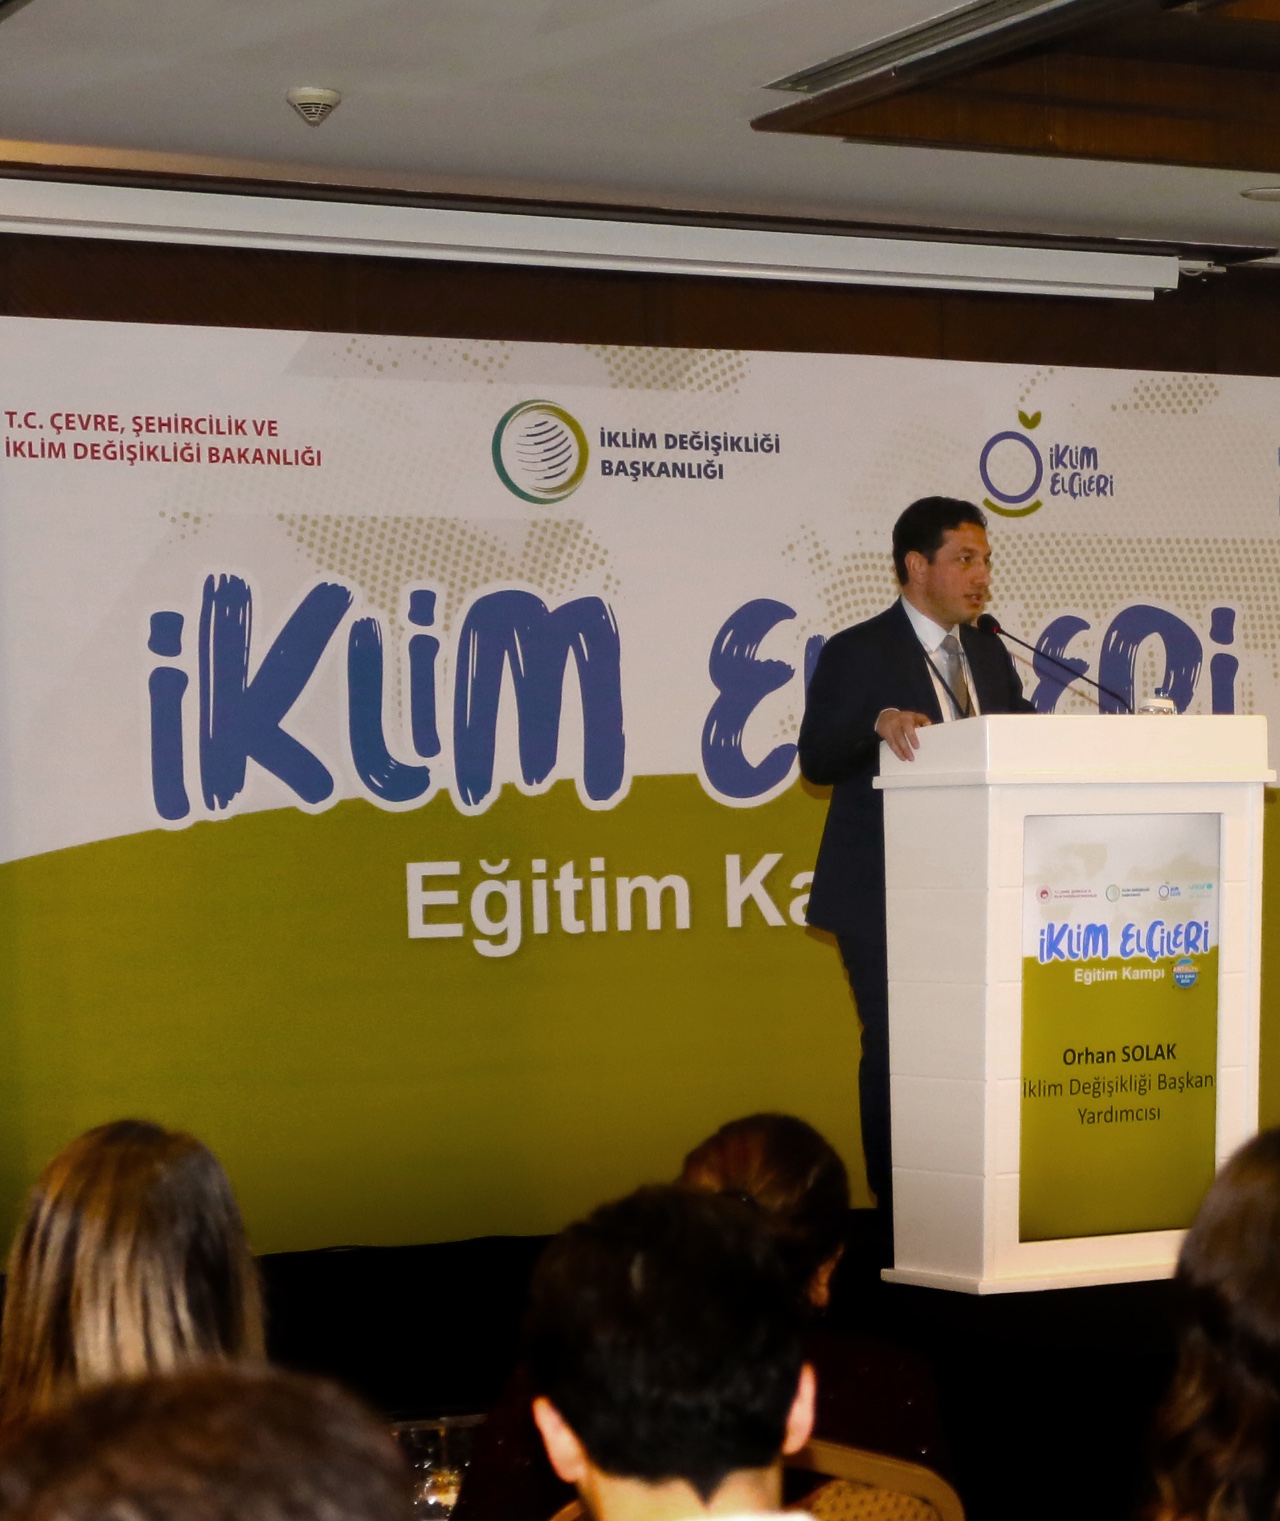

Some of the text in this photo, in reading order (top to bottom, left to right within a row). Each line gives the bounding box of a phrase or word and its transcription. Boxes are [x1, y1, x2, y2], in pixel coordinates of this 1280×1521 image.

[4, 411, 278, 437] T.C. ÇEVRE, ŞEHİRCİLİK VE
[4, 436, 322, 467] İKLİM DEĞİŞİKLİĞİ BAKANLIĞI
[599, 426, 780, 456] İKLİM DEĞİŞİKLİĞİ
[601, 459, 724, 482] BAŞKANLIĞI
[149, 573, 625, 821] İKLİM
[405, 856, 690, 958] Eğitim
[1039, 920, 1209, 964] İKLİM ELÇİLERİ
[1074, 966, 1165, 986] Eğitim Kampı
[1062, 1042, 1177, 1066] Orhan SOLAK
[1023, 1070, 1214, 1099] İklim Değişikliği Başkan
[1077, 1104, 1161, 1125] Yardımcısı
